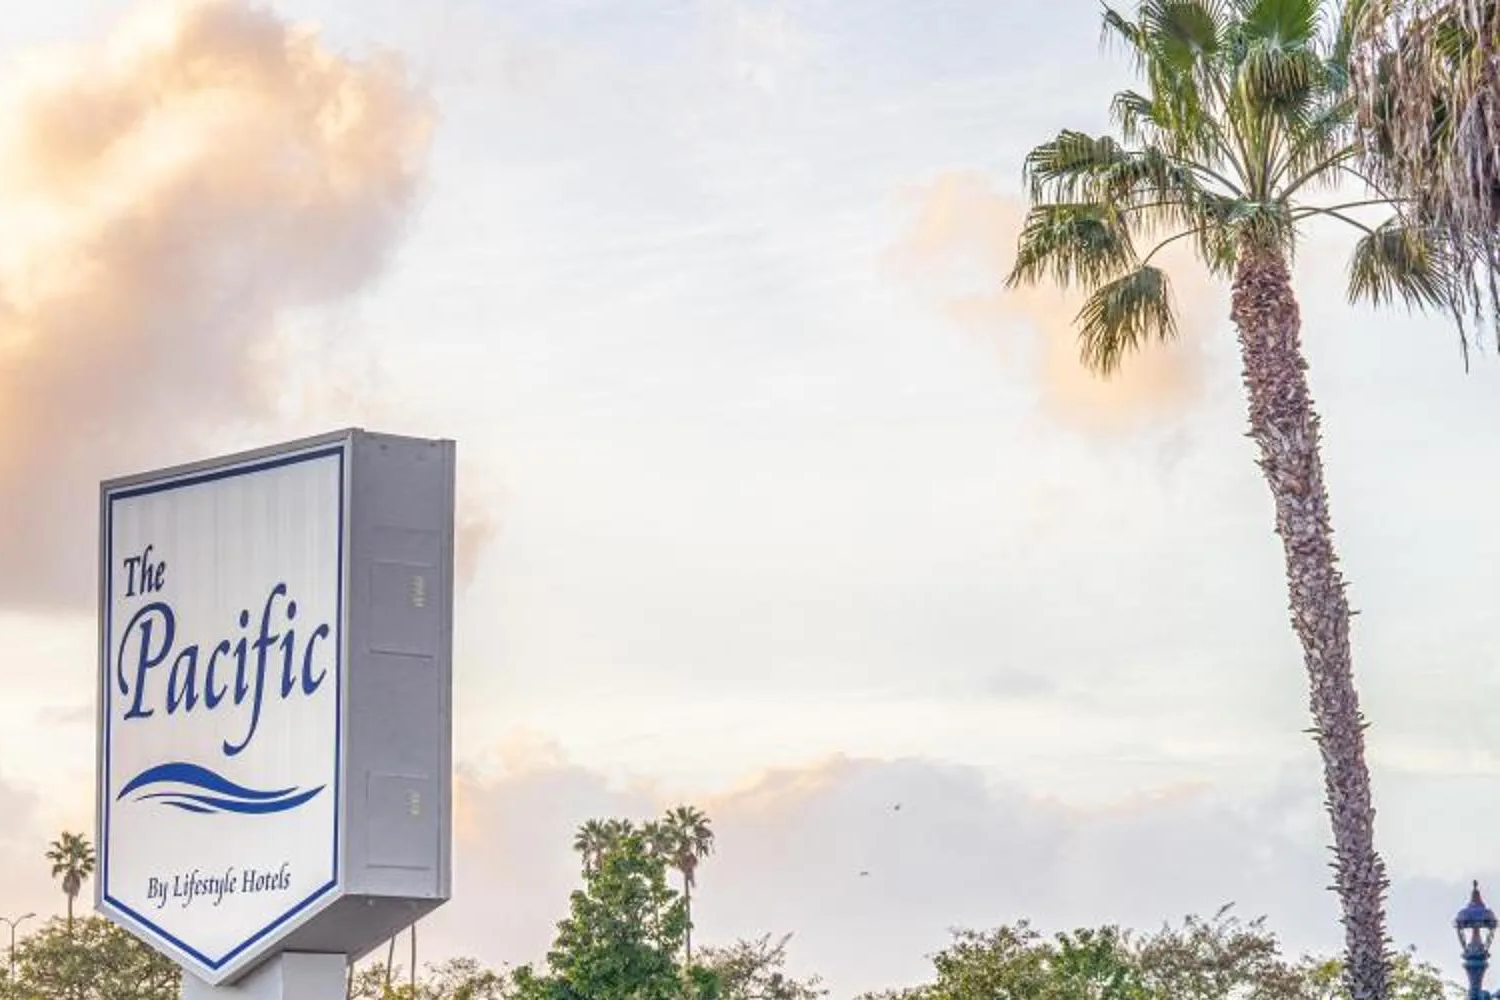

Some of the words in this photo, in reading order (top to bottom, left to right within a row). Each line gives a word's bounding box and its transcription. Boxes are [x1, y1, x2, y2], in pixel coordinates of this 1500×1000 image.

[123, 543, 167, 597] The
[116, 582, 330, 757] Pacific
[147, 876, 169, 909] By
[173, 866, 238, 909] Lifestyle
[241, 861, 292, 893] Hotels
